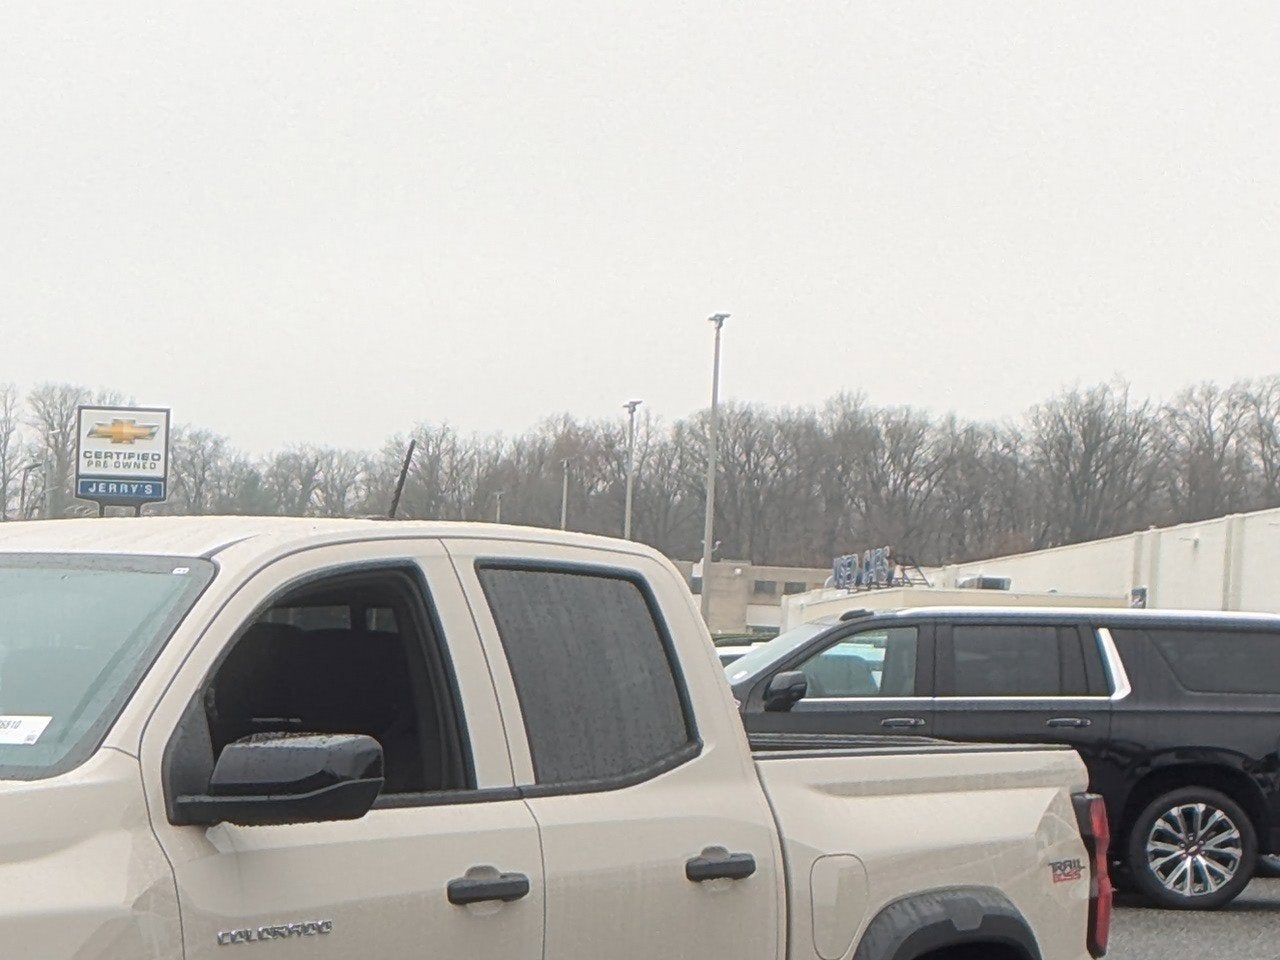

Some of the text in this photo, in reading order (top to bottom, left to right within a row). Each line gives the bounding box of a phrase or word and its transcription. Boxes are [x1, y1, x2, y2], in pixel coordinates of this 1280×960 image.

[83, 450, 162, 461] CERTIFIED
[87, 460, 157, 470] PRE OWNED
[88, 482, 153, 495] JERRY'S
[217, 920, 333, 945] COLORADO
